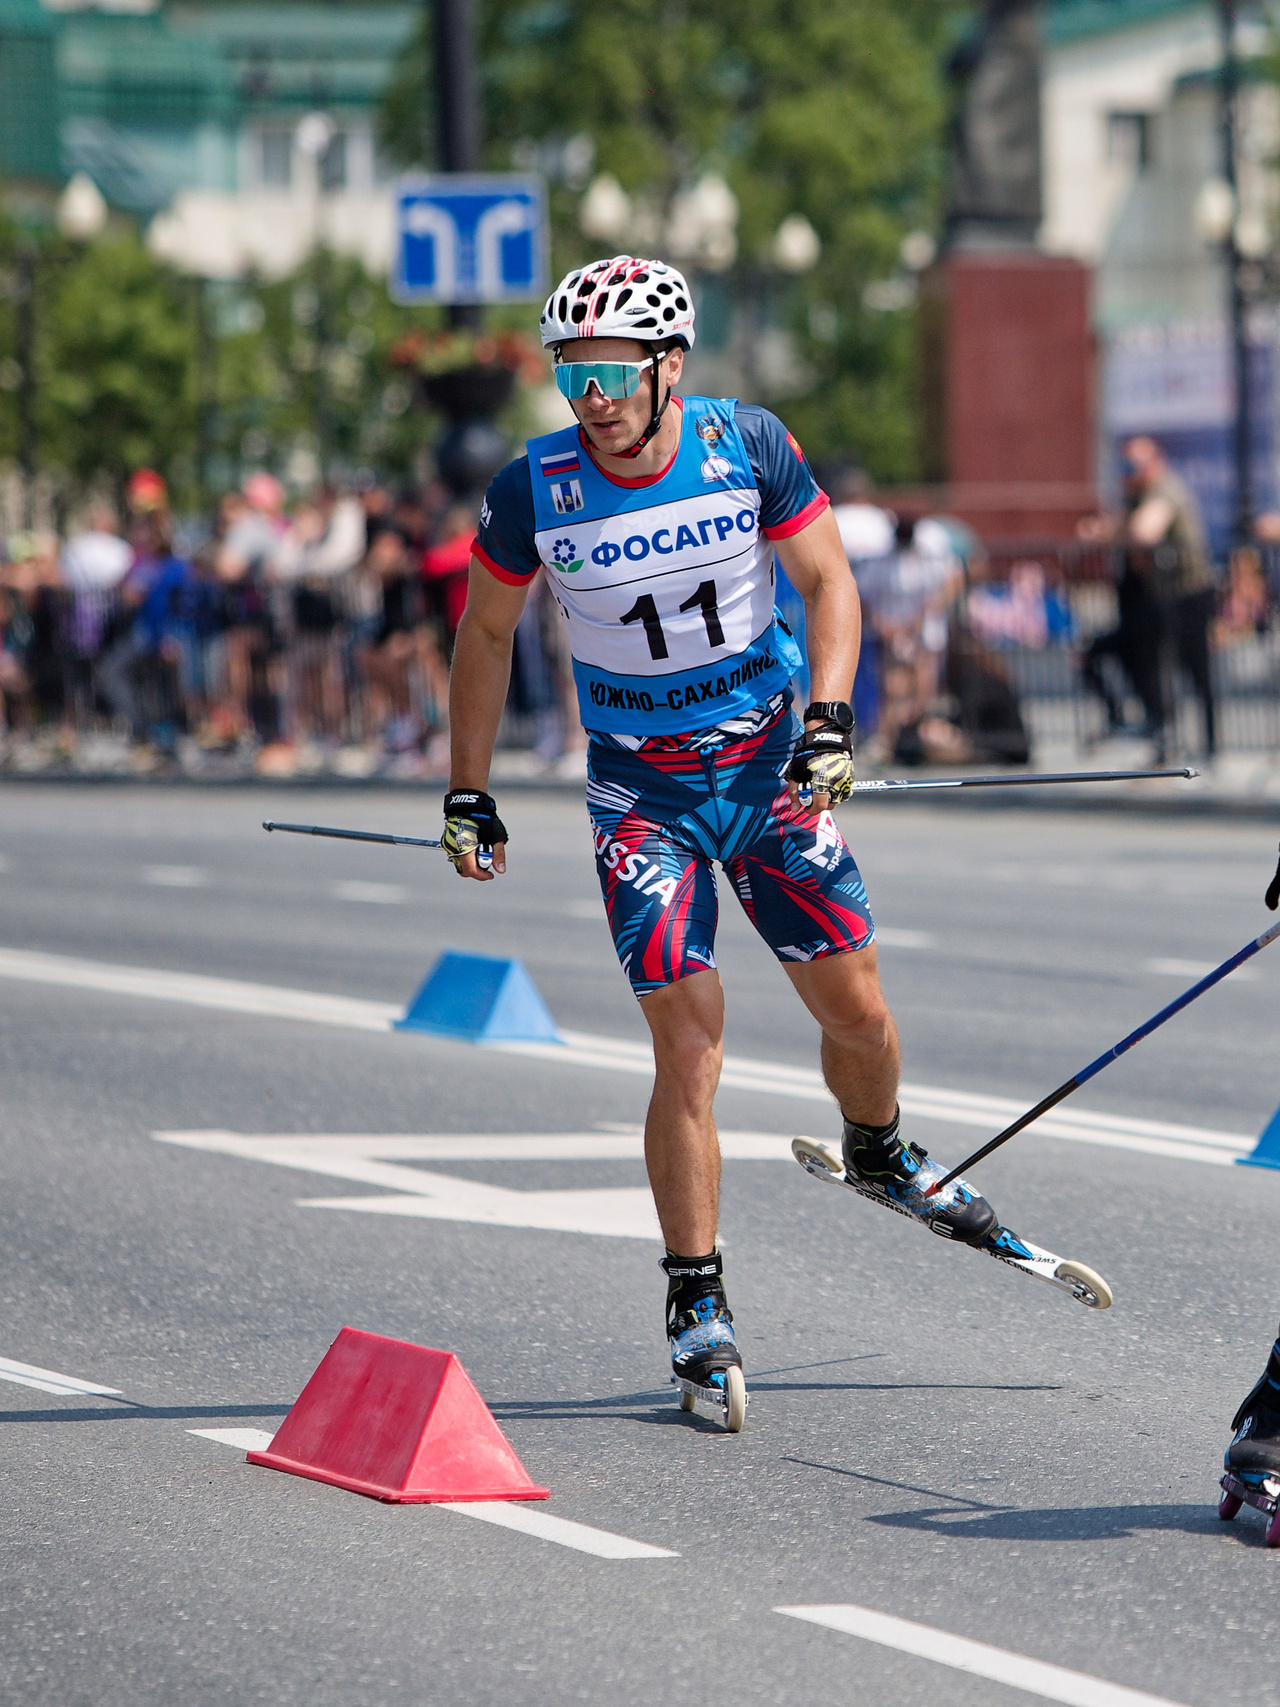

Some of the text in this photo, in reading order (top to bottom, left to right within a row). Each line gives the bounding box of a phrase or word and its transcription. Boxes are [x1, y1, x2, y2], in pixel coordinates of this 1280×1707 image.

[591, 508, 756, 568] ФОСАГРО
[619, 579, 725, 660] 11
[668, 1264, 717, 1276] SPINE
